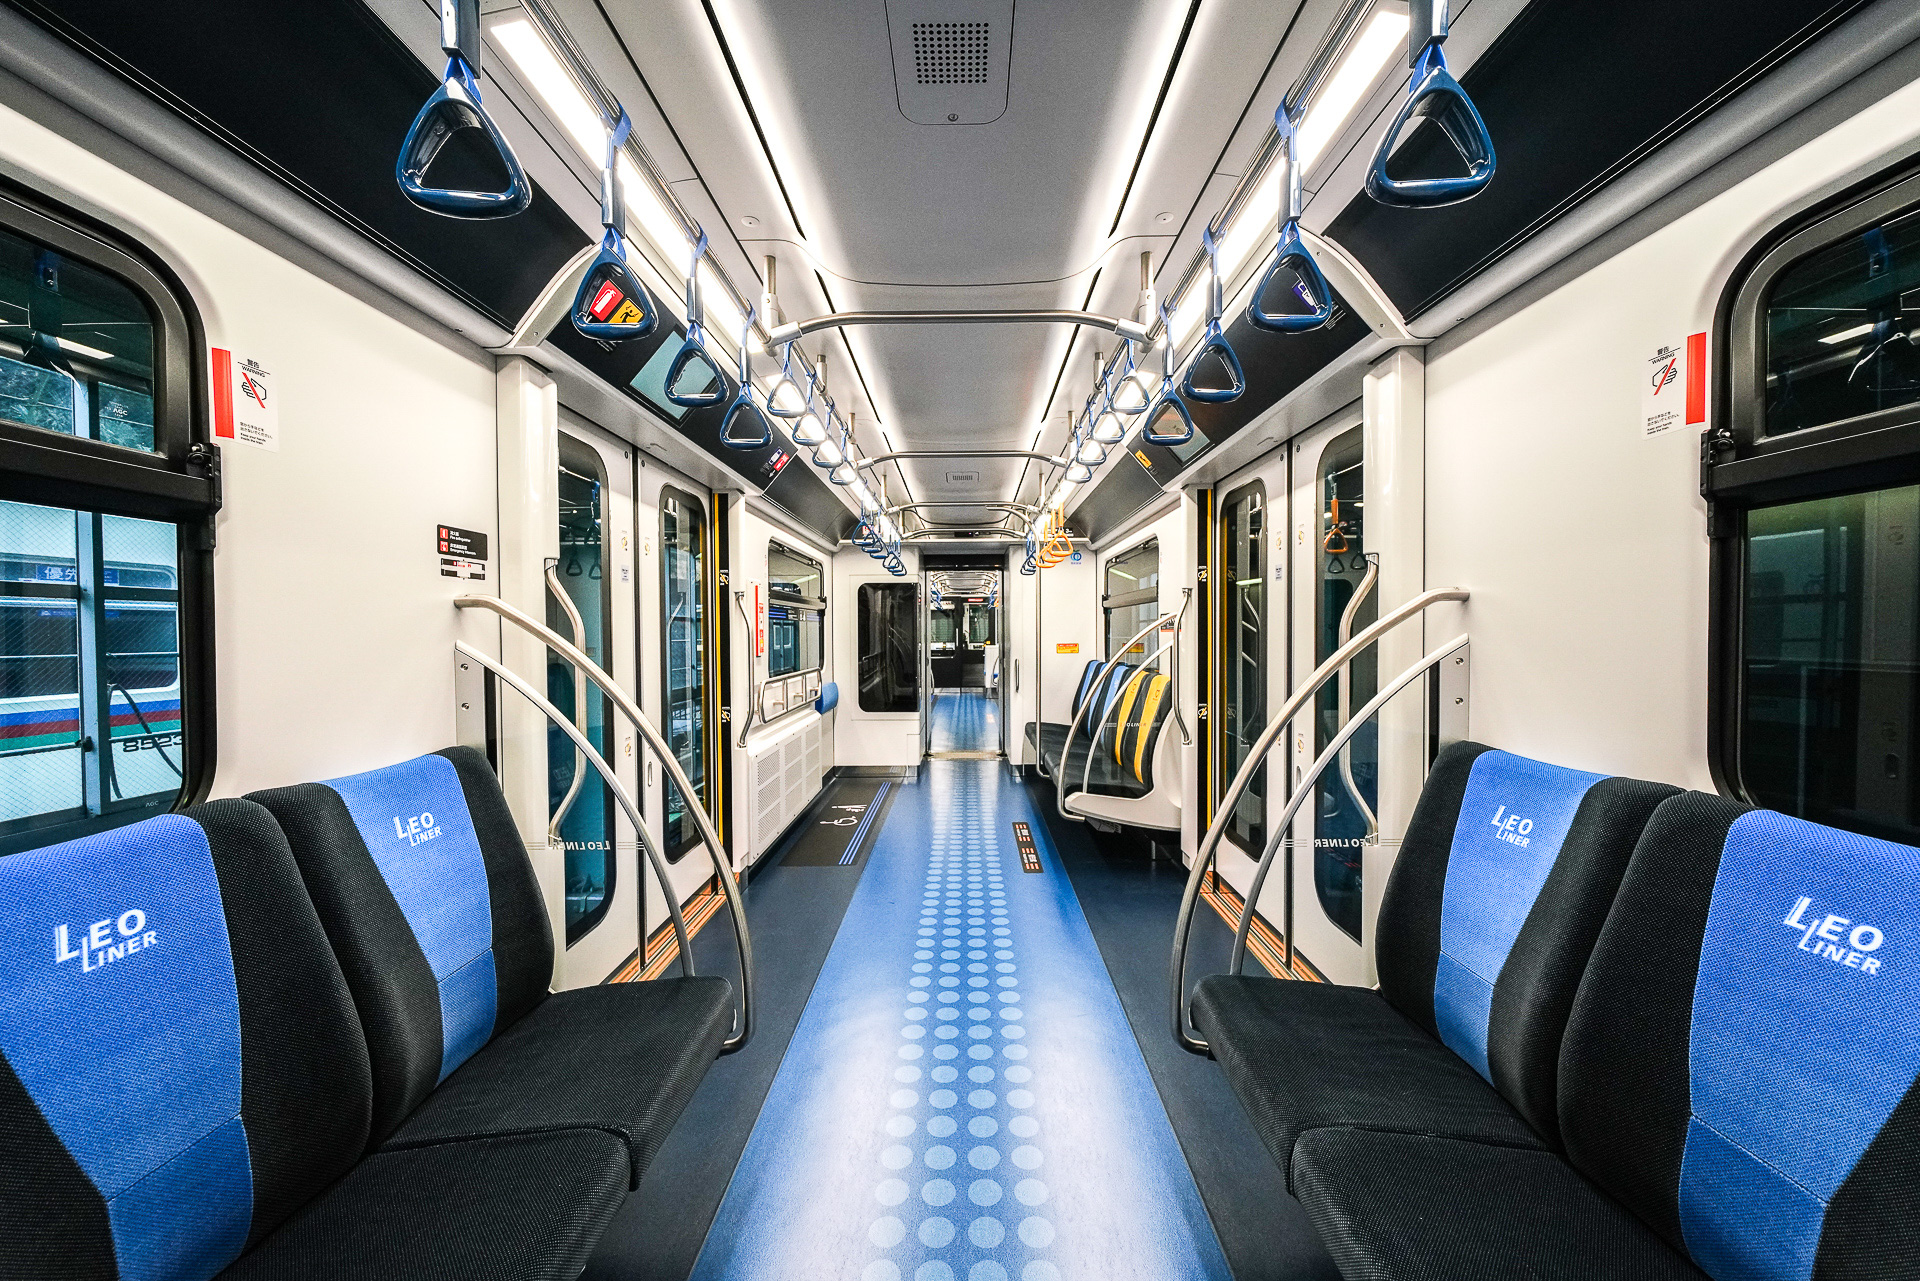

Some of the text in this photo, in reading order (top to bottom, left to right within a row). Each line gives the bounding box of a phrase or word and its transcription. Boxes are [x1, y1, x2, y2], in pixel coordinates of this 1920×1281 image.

[241, 365, 266, 378] WARNING
[1652, 353, 1675, 364] WARNING
[393, 812, 434, 839] LEO
[1491, 805, 1533, 835] LEO
[1496, 818, 1530, 848] LINER
[407, 825, 442, 847] LINER
[55, 909, 146, 963] LEO
[1783, 895, 1883, 951] LEO
[82, 930, 157, 973] LINER
[1798, 919, 1881, 975] LINER
